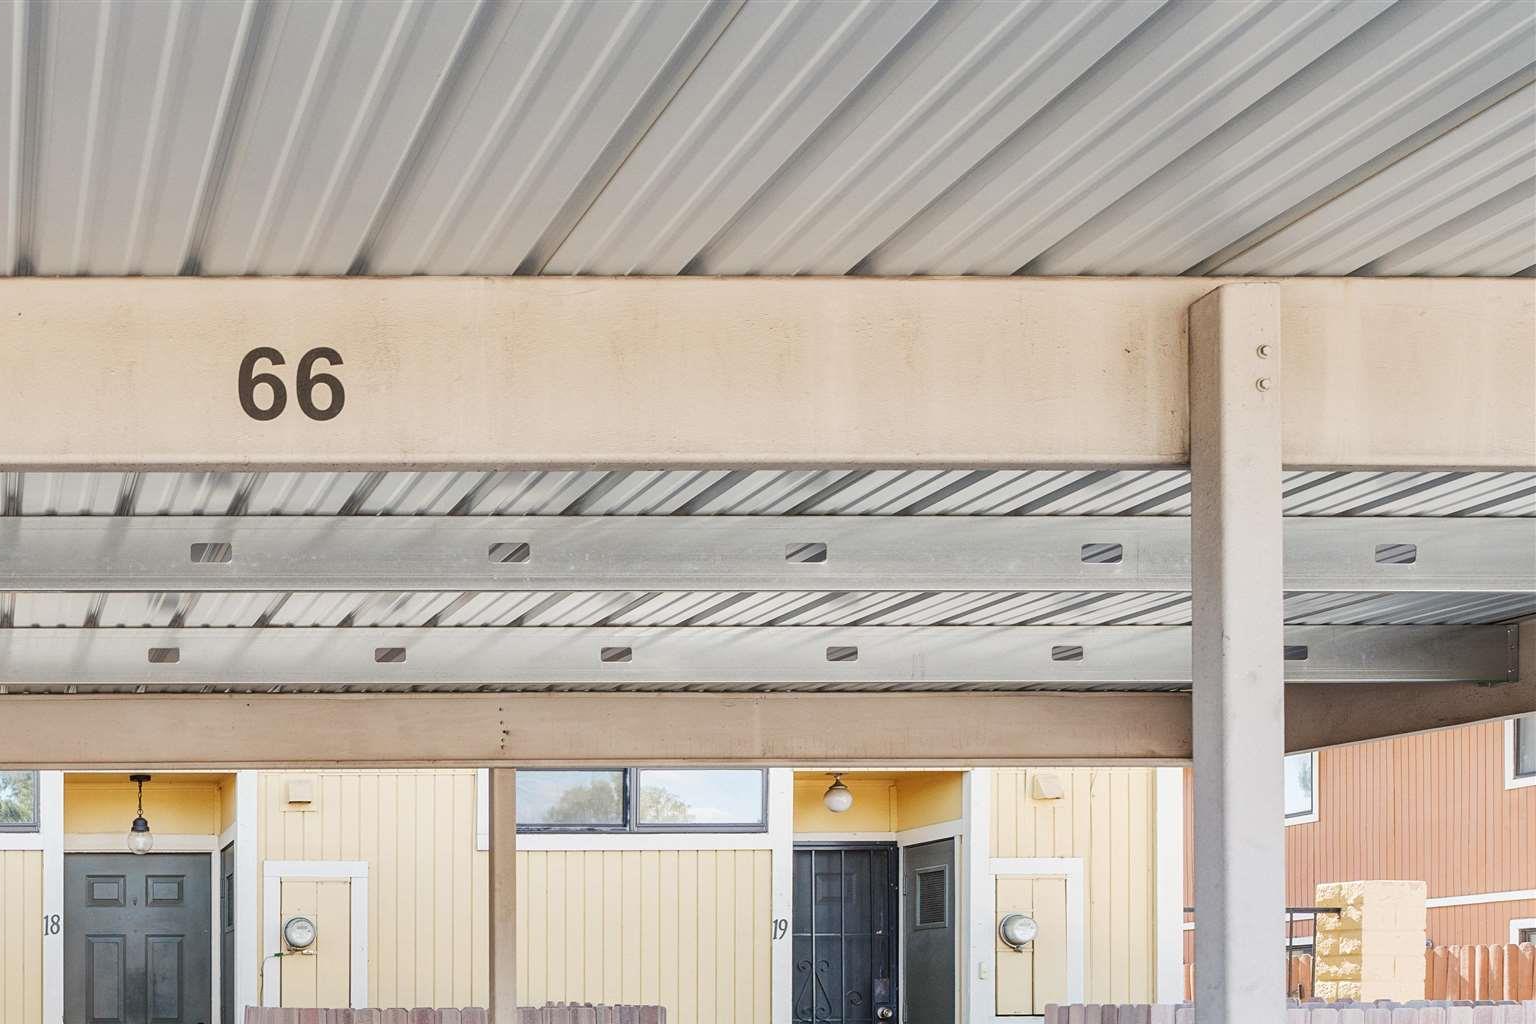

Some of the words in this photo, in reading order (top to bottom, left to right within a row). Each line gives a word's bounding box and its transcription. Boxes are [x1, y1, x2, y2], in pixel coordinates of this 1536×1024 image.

[238, 346, 345, 421] 66
[43, 914, 60, 936] 18
[772, 919, 788, 940] 19
